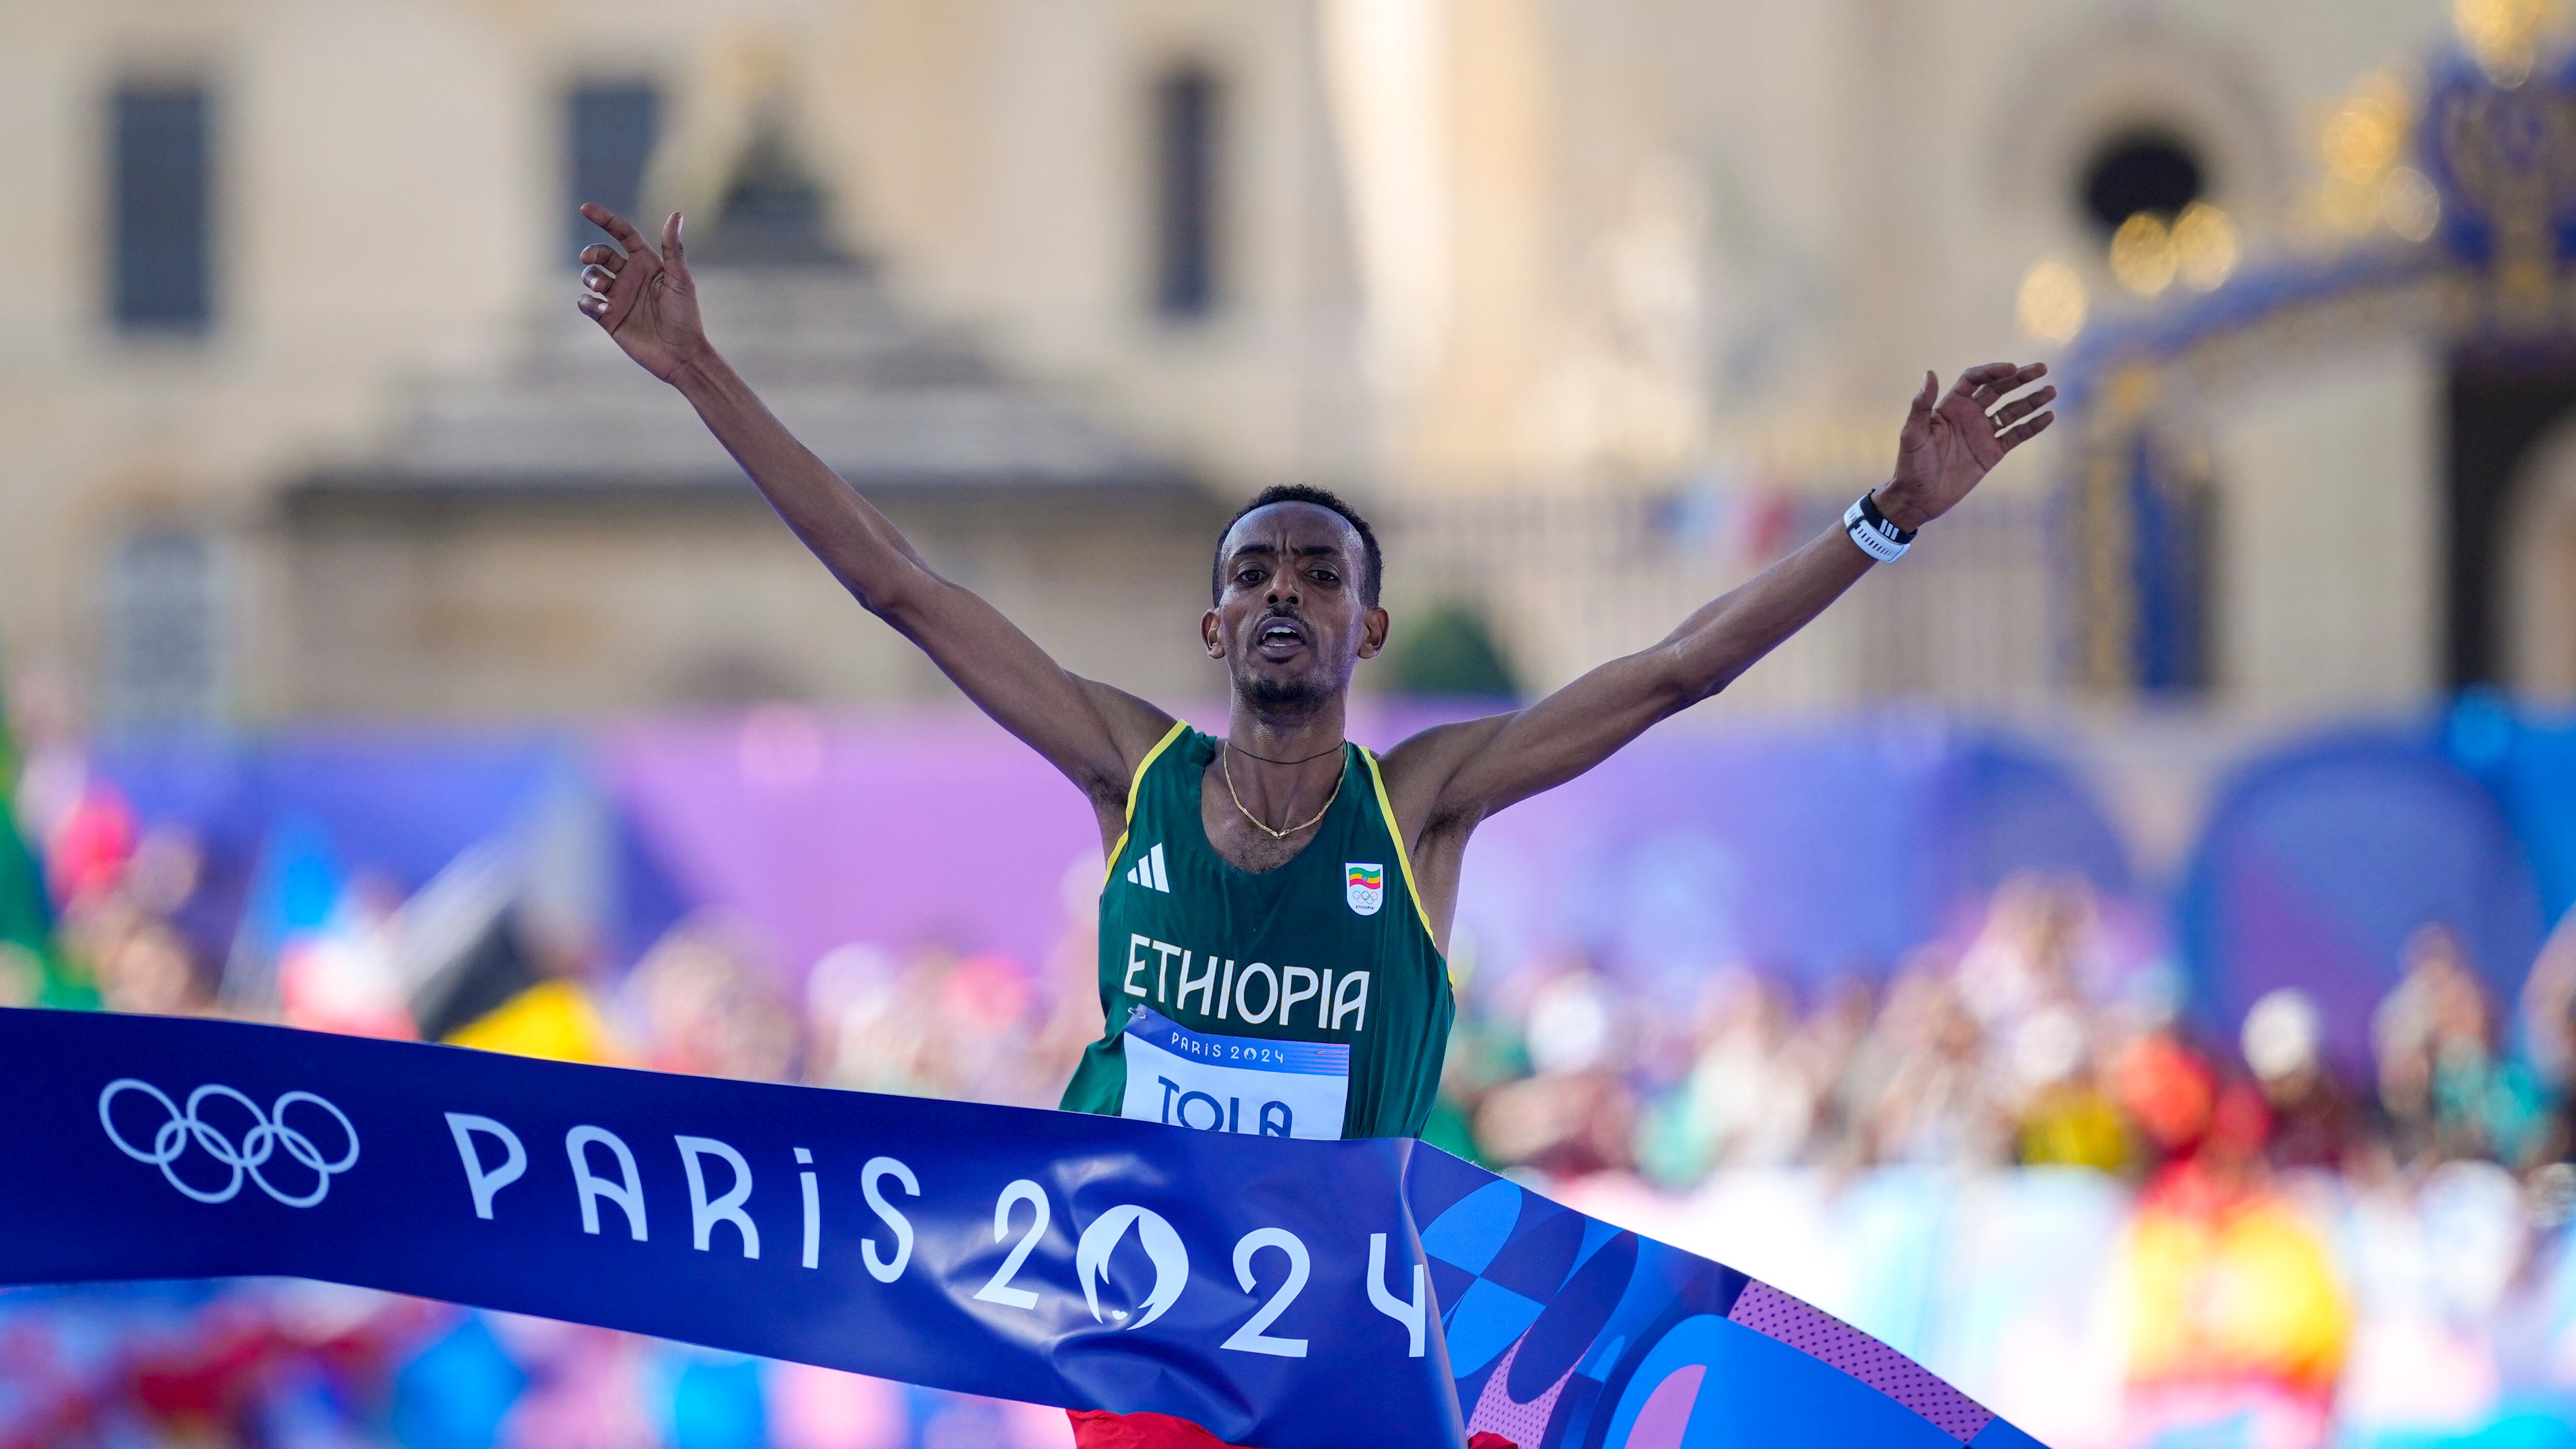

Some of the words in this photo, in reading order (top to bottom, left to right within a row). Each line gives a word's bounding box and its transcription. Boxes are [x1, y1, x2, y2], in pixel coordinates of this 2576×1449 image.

[1123, 933, 1370, 1031] ETHIOPIA
[1230, 1046, 1284, 1064] 2024
[972, 1179, 1426, 1358] 2024
